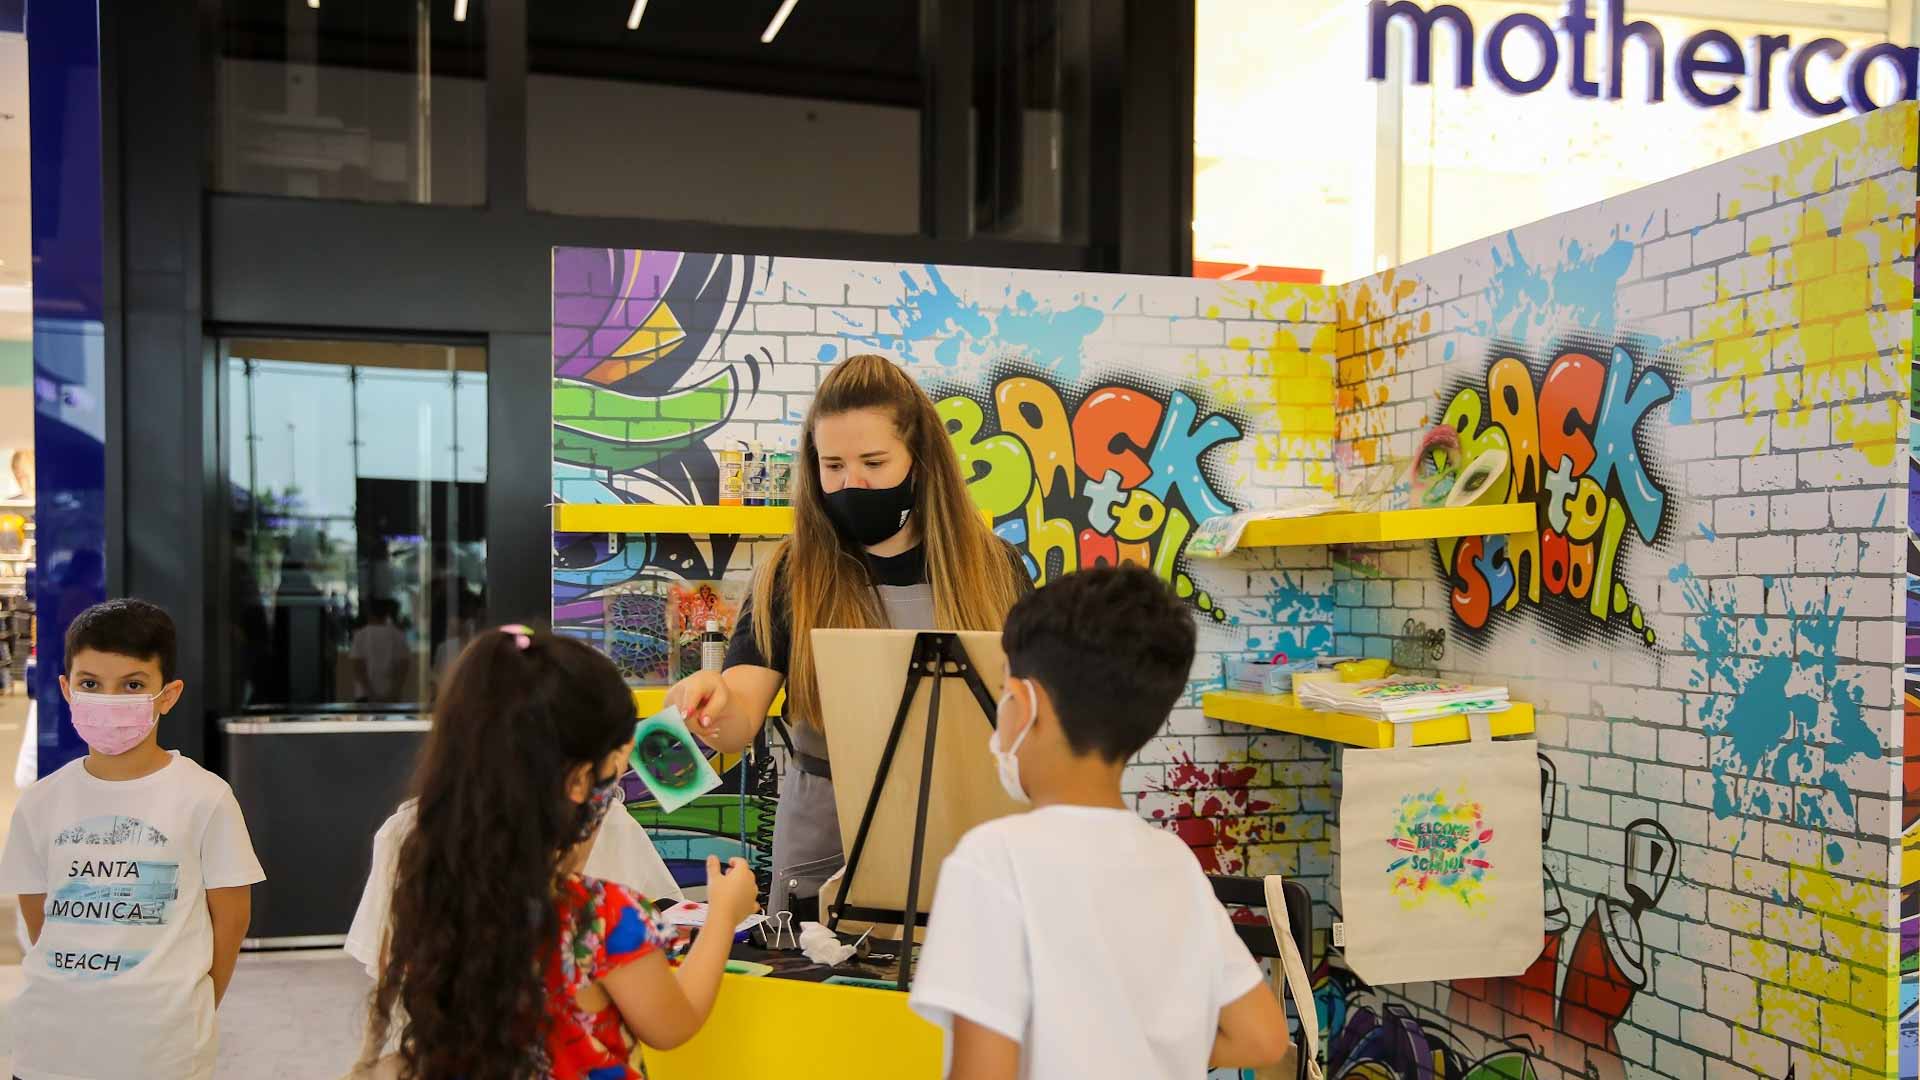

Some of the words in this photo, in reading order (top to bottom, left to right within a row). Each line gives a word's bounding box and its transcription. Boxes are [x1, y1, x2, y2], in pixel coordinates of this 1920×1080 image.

[932, 376, 1244, 526] BACK
[1083, 468, 1166, 541] to
[1545, 454, 1607, 541] to
[68, 860, 140, 878] SANTA
[52, 900, 144, 919] MONICA
[54, 952, 121, 971] BEACH
